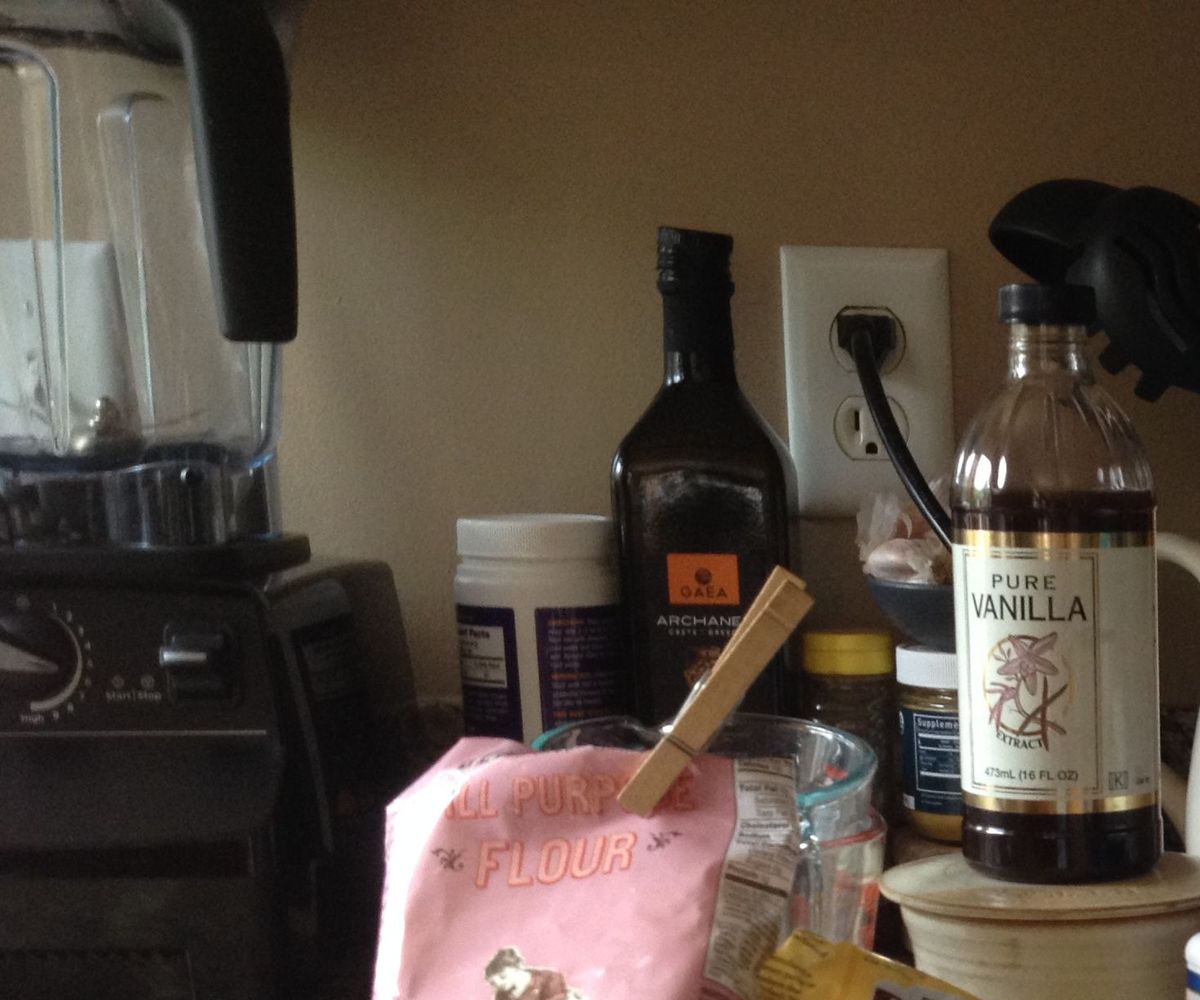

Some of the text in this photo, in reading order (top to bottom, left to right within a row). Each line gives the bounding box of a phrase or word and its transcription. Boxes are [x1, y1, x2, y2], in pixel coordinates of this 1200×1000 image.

[991, 573, 1057, 591] PURE
[679, 584, 728, 599] GAEA
[971, 592, 1087, 622] VANILLA
[656, 615, 741, 627] ARCHANE
[916, 716, 960, 730] Suppleme
[995, 731, 1044, 751] EXTRACT
[984, 766, 1080, 783] 473mL (16 FL OZ)
[512, 770, 699, 817] PURPE
[474, 831, 639, 890] FLOUR
